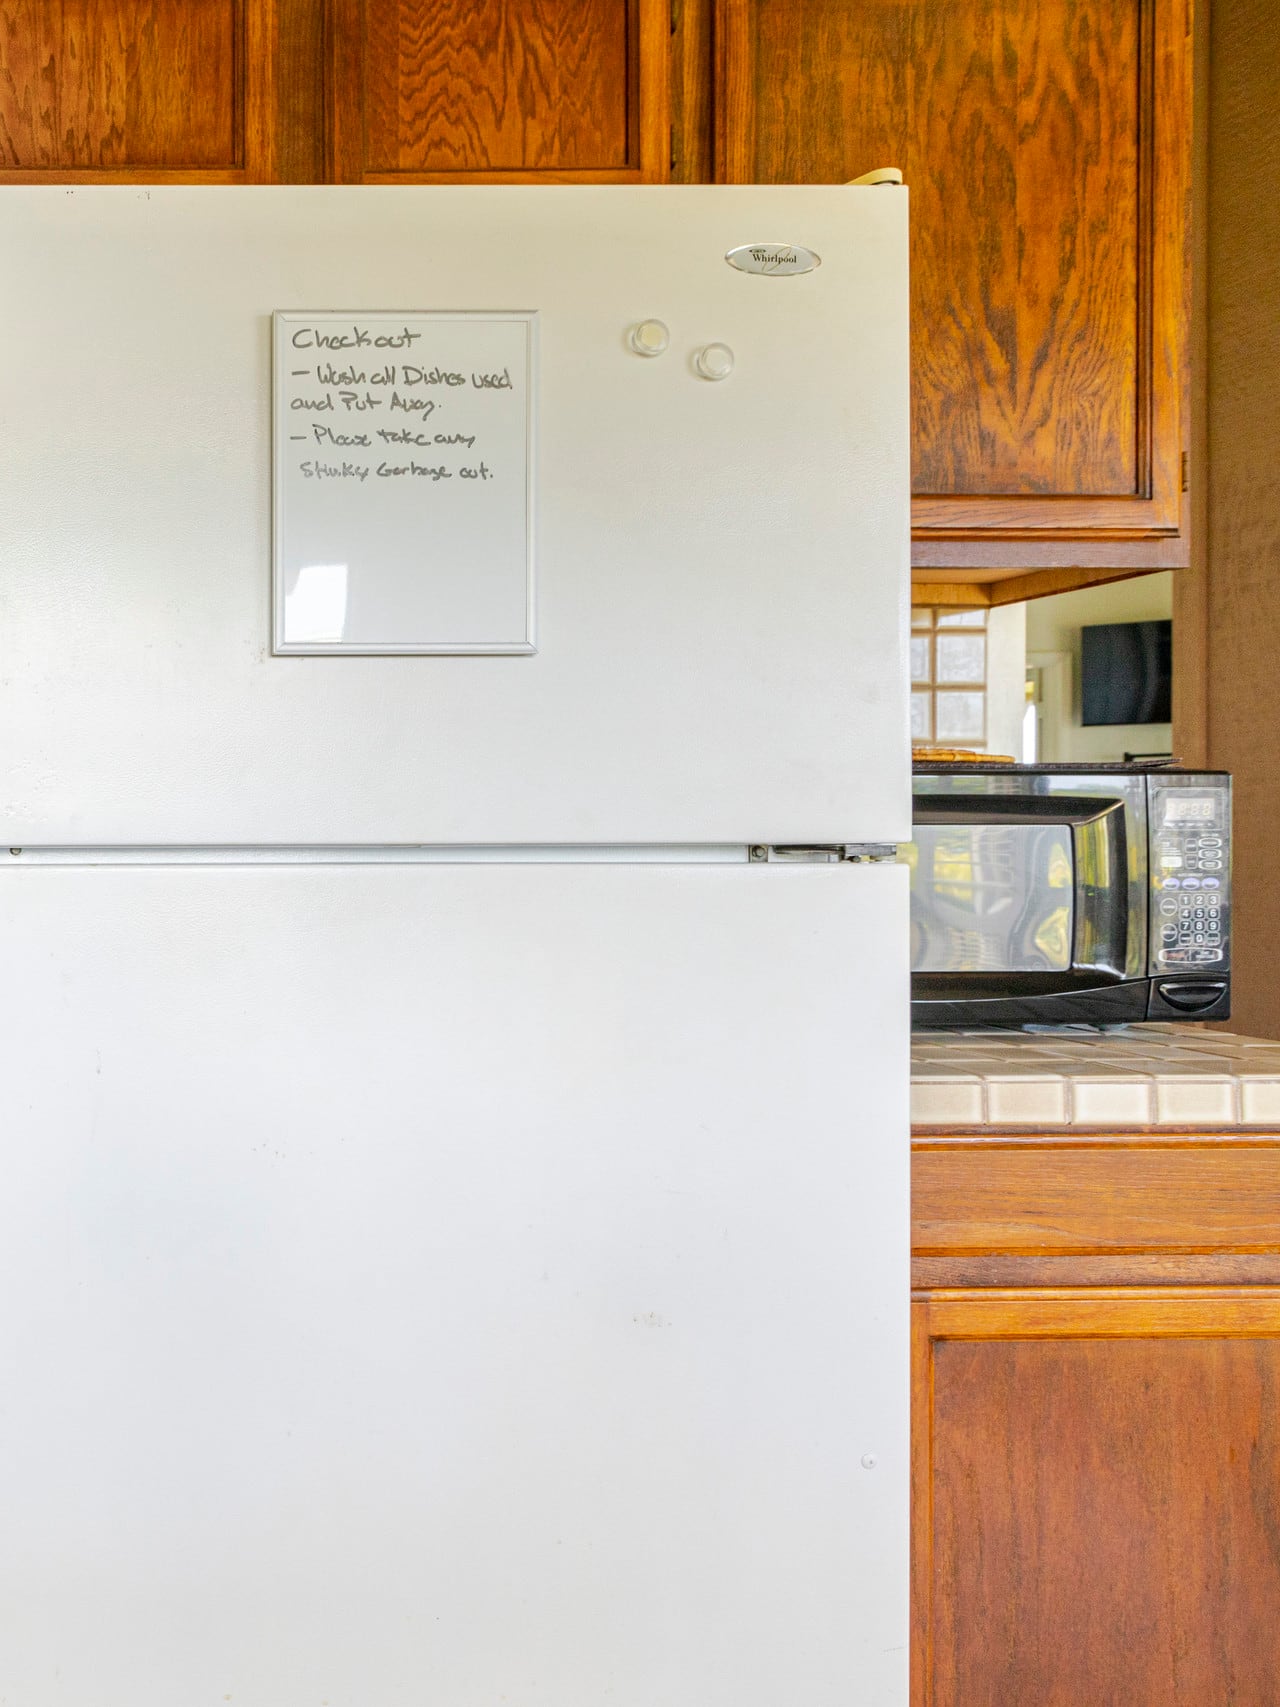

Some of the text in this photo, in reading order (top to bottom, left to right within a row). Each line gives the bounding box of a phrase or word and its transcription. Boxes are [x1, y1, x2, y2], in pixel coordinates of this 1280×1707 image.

[752, 253, 797, 265] Whirlpool
[291, 327, 422, 350] Checkout
[317, 363, 367, 386] Wash
[370, 365, 396, 385] all
[402, 365, 467, 387] Dishes
[471, 368, 513, 389] used
[290, 394, 335, 411] and
[338, 391, 383, 411] Put
[312, 423, 372, 446] Please
[376, 428, 431, 446] take
[1183, 896, 1217, 905] 1 2 3
[1182, 909, 1217, 917] 4 5 6
[1182, 922, 1217, 930] 7 8 9
[1196, 934, 1203, 943] 0
